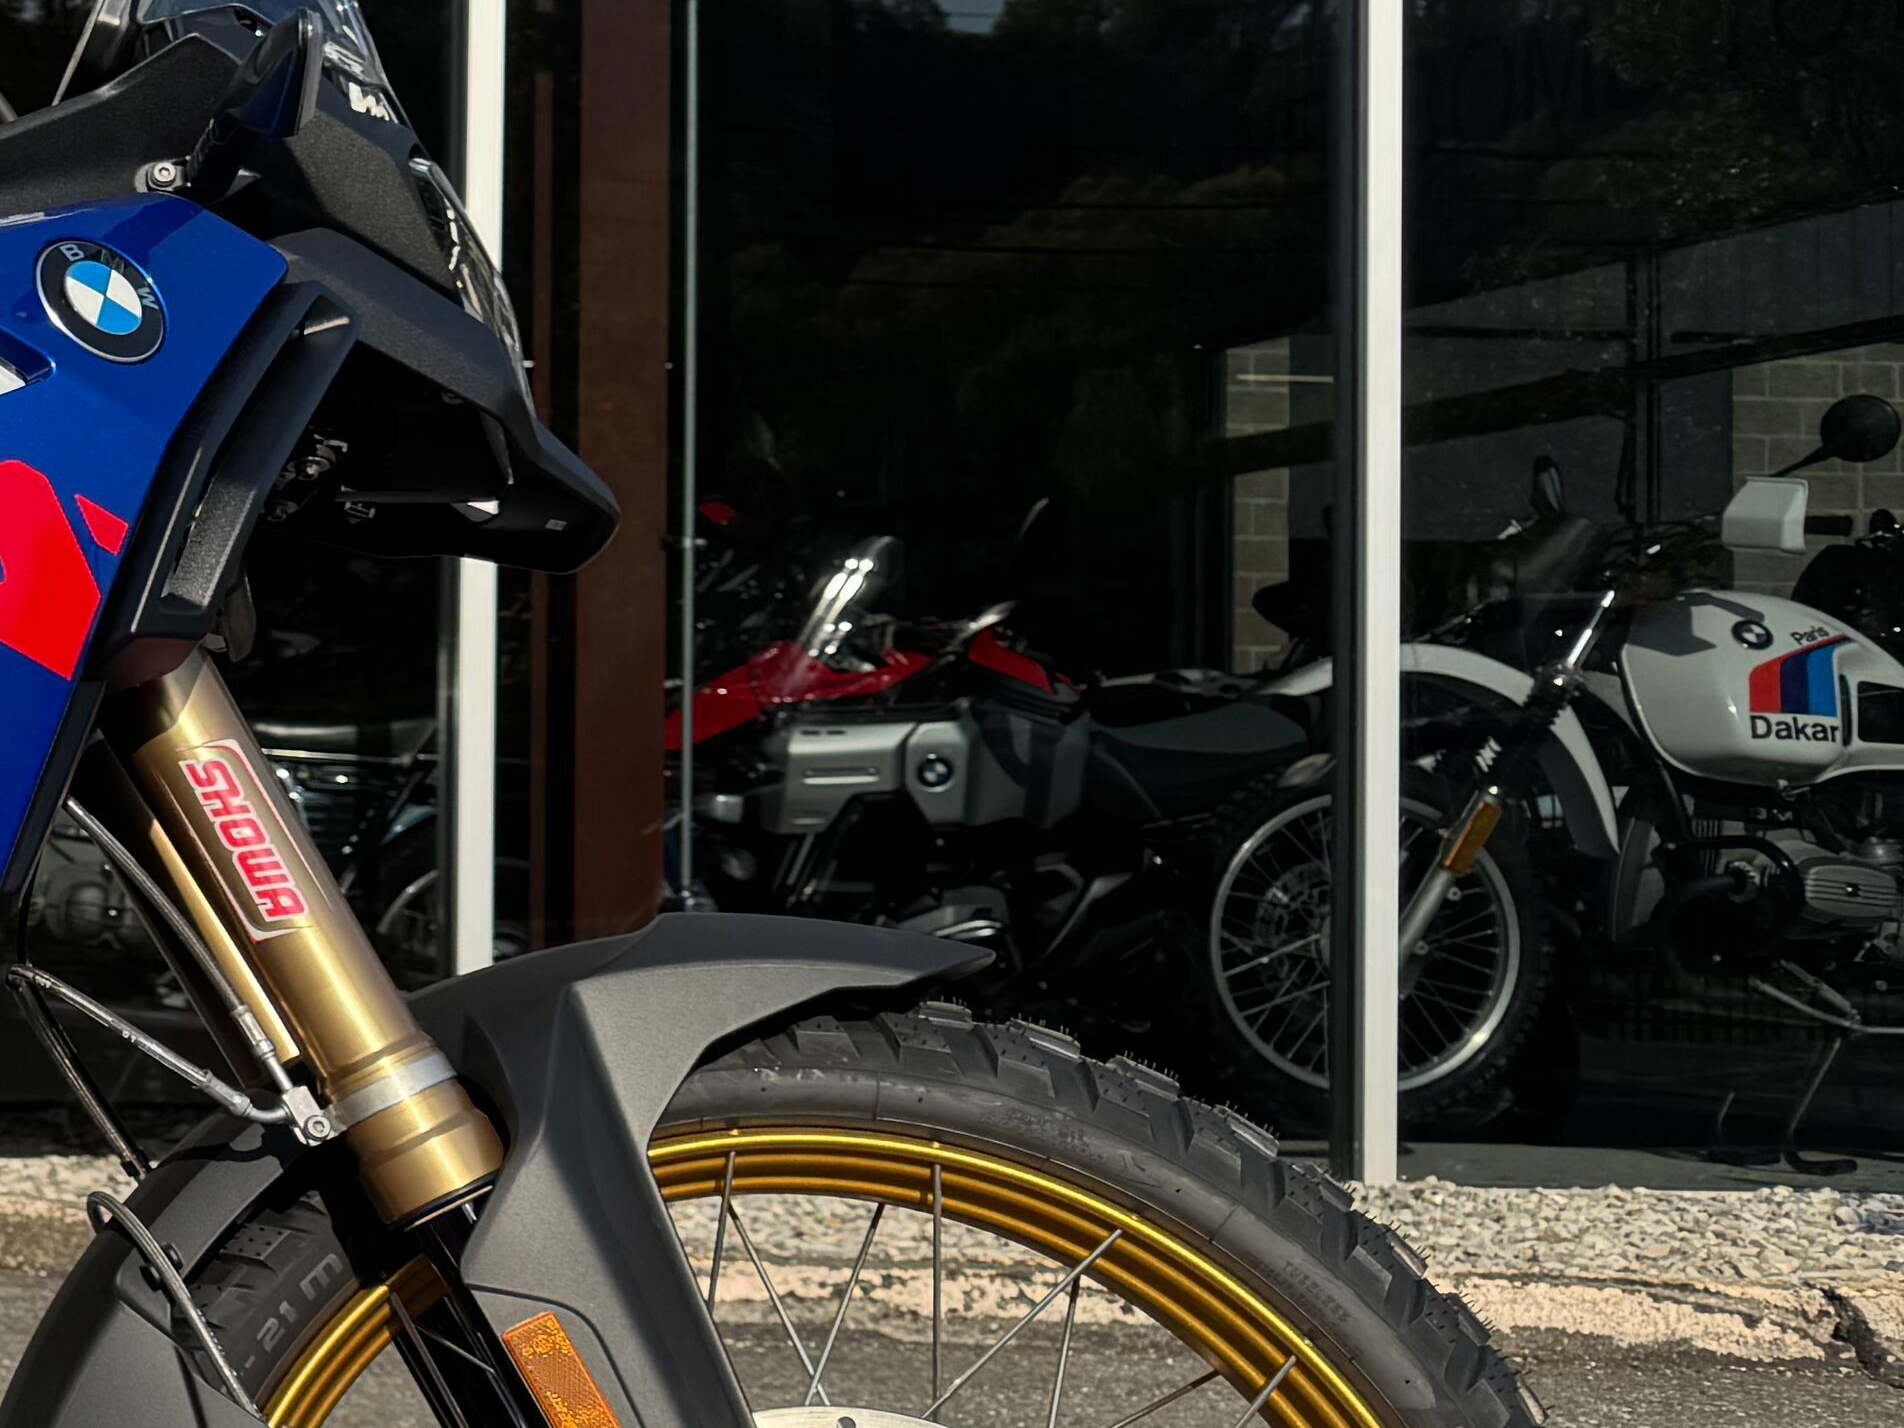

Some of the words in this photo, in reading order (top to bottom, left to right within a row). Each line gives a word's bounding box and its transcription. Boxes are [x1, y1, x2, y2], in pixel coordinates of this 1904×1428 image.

[1789, 624, 1830, 646] Paris
[1749, 714, 1840, 744] Dakar
[179, 758, 311, 922] SHOWA
[256, 1302, 300, 1352] 21
